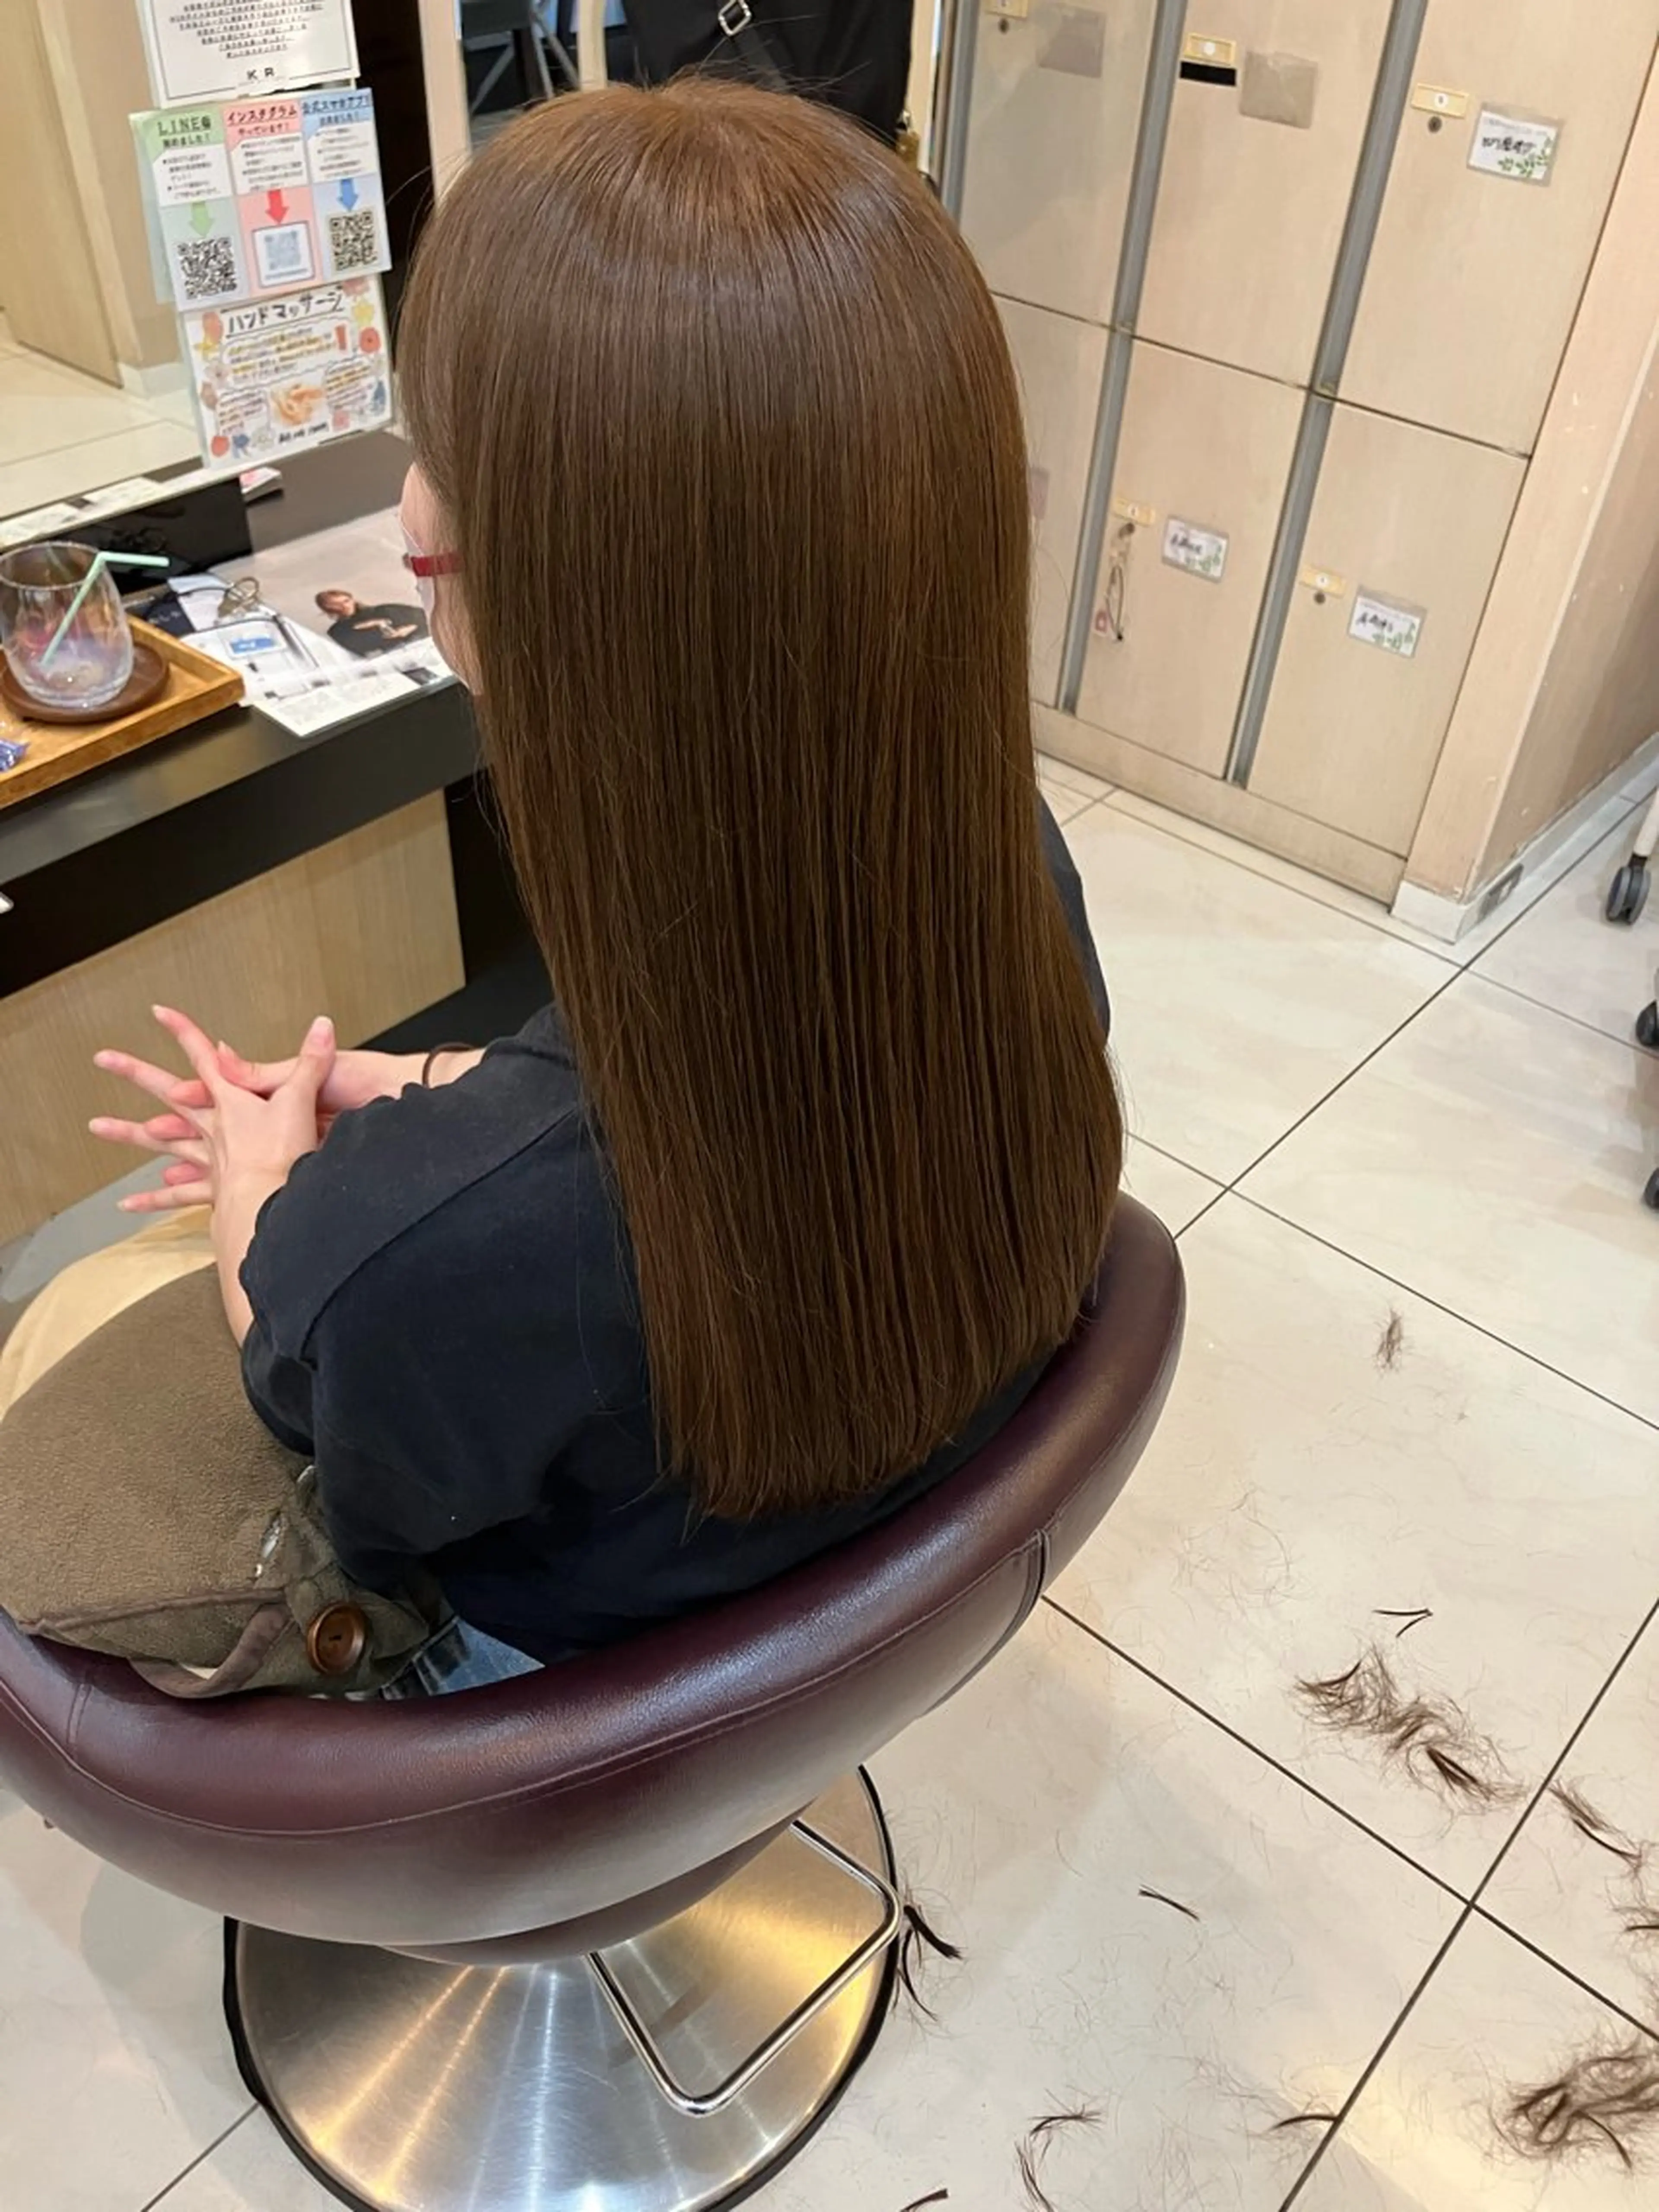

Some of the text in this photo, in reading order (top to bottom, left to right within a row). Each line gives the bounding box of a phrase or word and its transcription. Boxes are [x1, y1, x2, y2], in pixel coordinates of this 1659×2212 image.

[228, 105, 297, 123] インスタグラム
[229, 284, 344, 333] ハンドマッサージ
